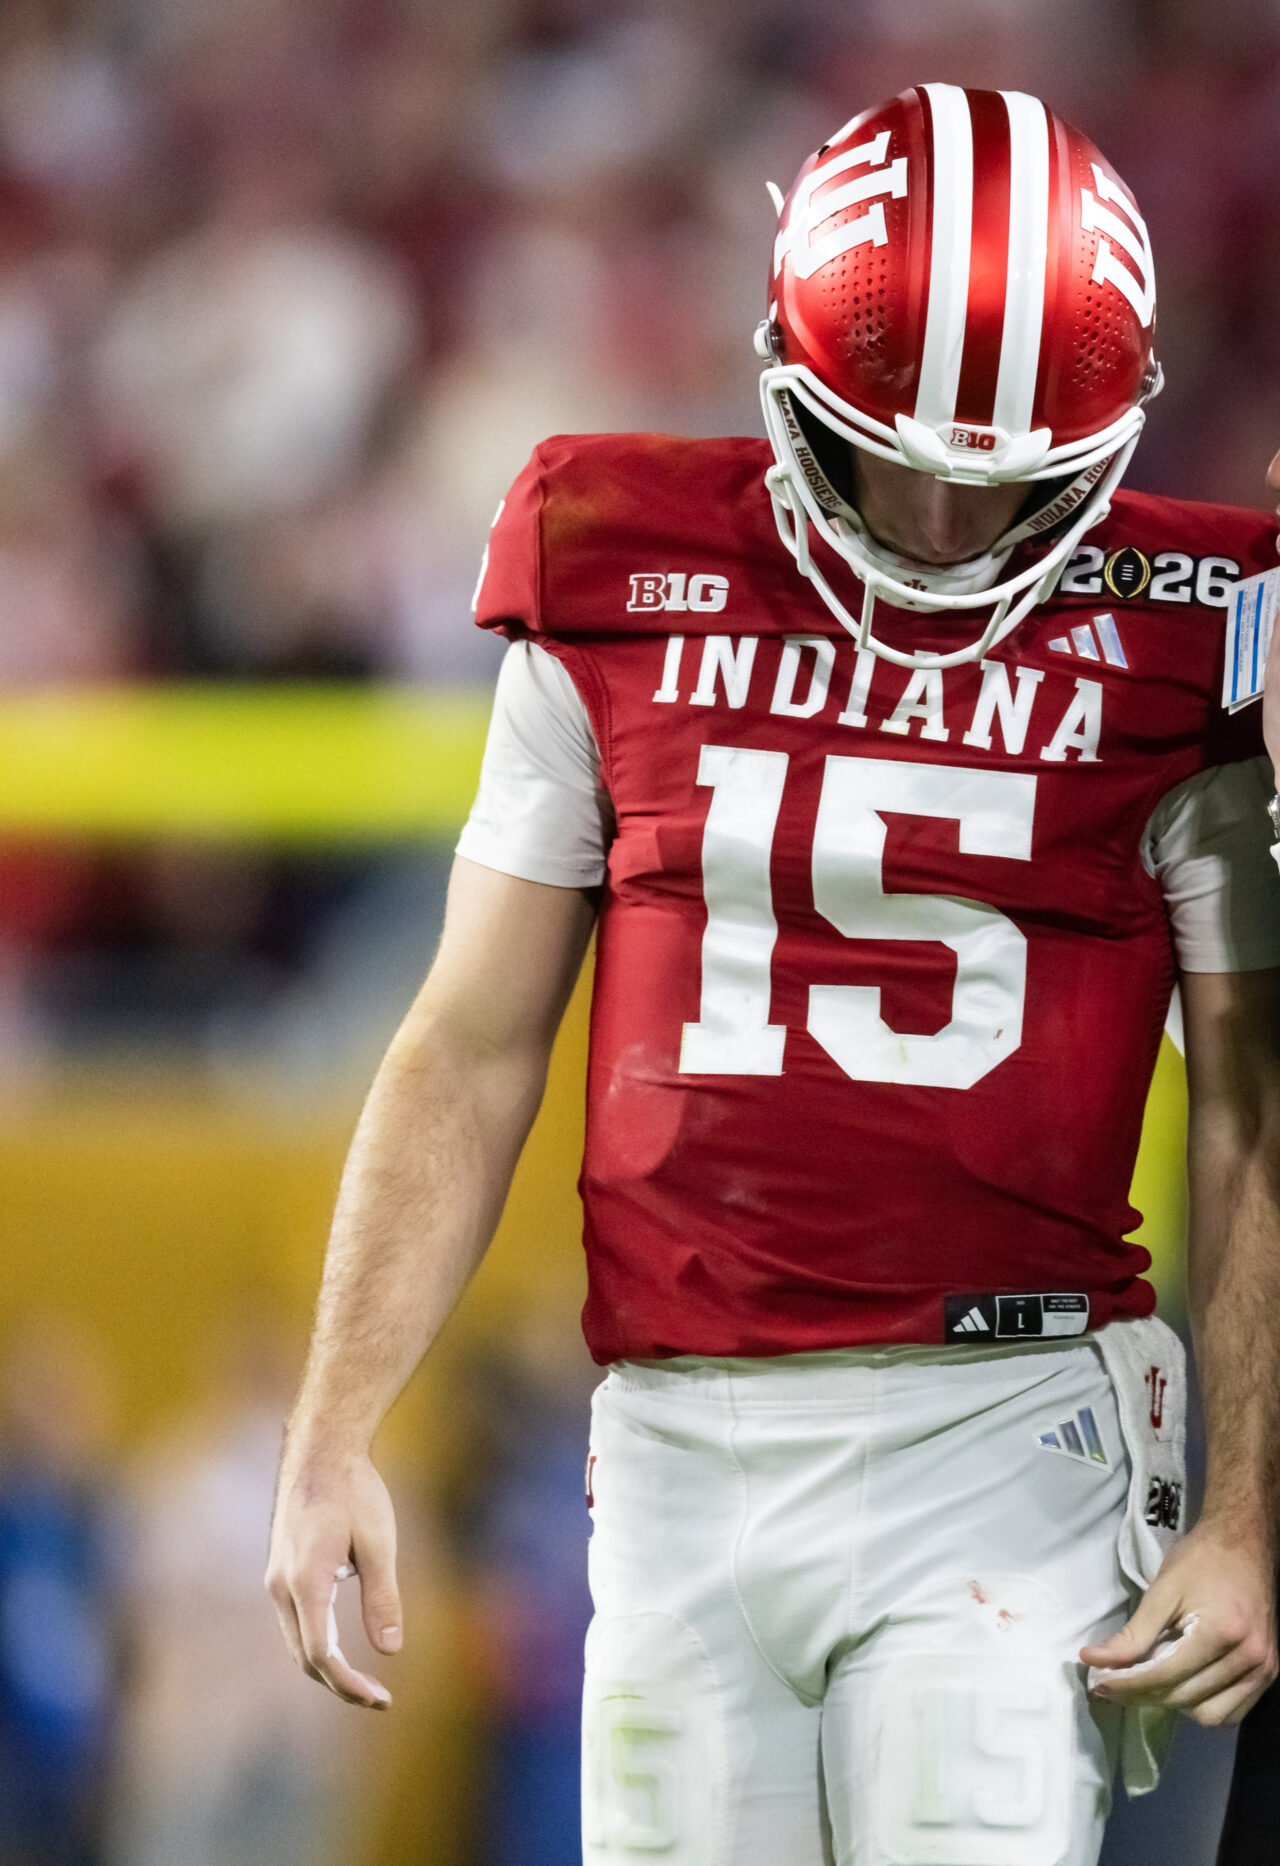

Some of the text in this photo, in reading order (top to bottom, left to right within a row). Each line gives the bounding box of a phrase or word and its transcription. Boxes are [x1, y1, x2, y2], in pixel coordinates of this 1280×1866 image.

[795, 446, 843, 509] HOOSIERS
[1026, 486, 1088, 531] INDIANA
[652, 634, 1104, 763] INDIANA
[678, 744, 1038, 1091] 15
